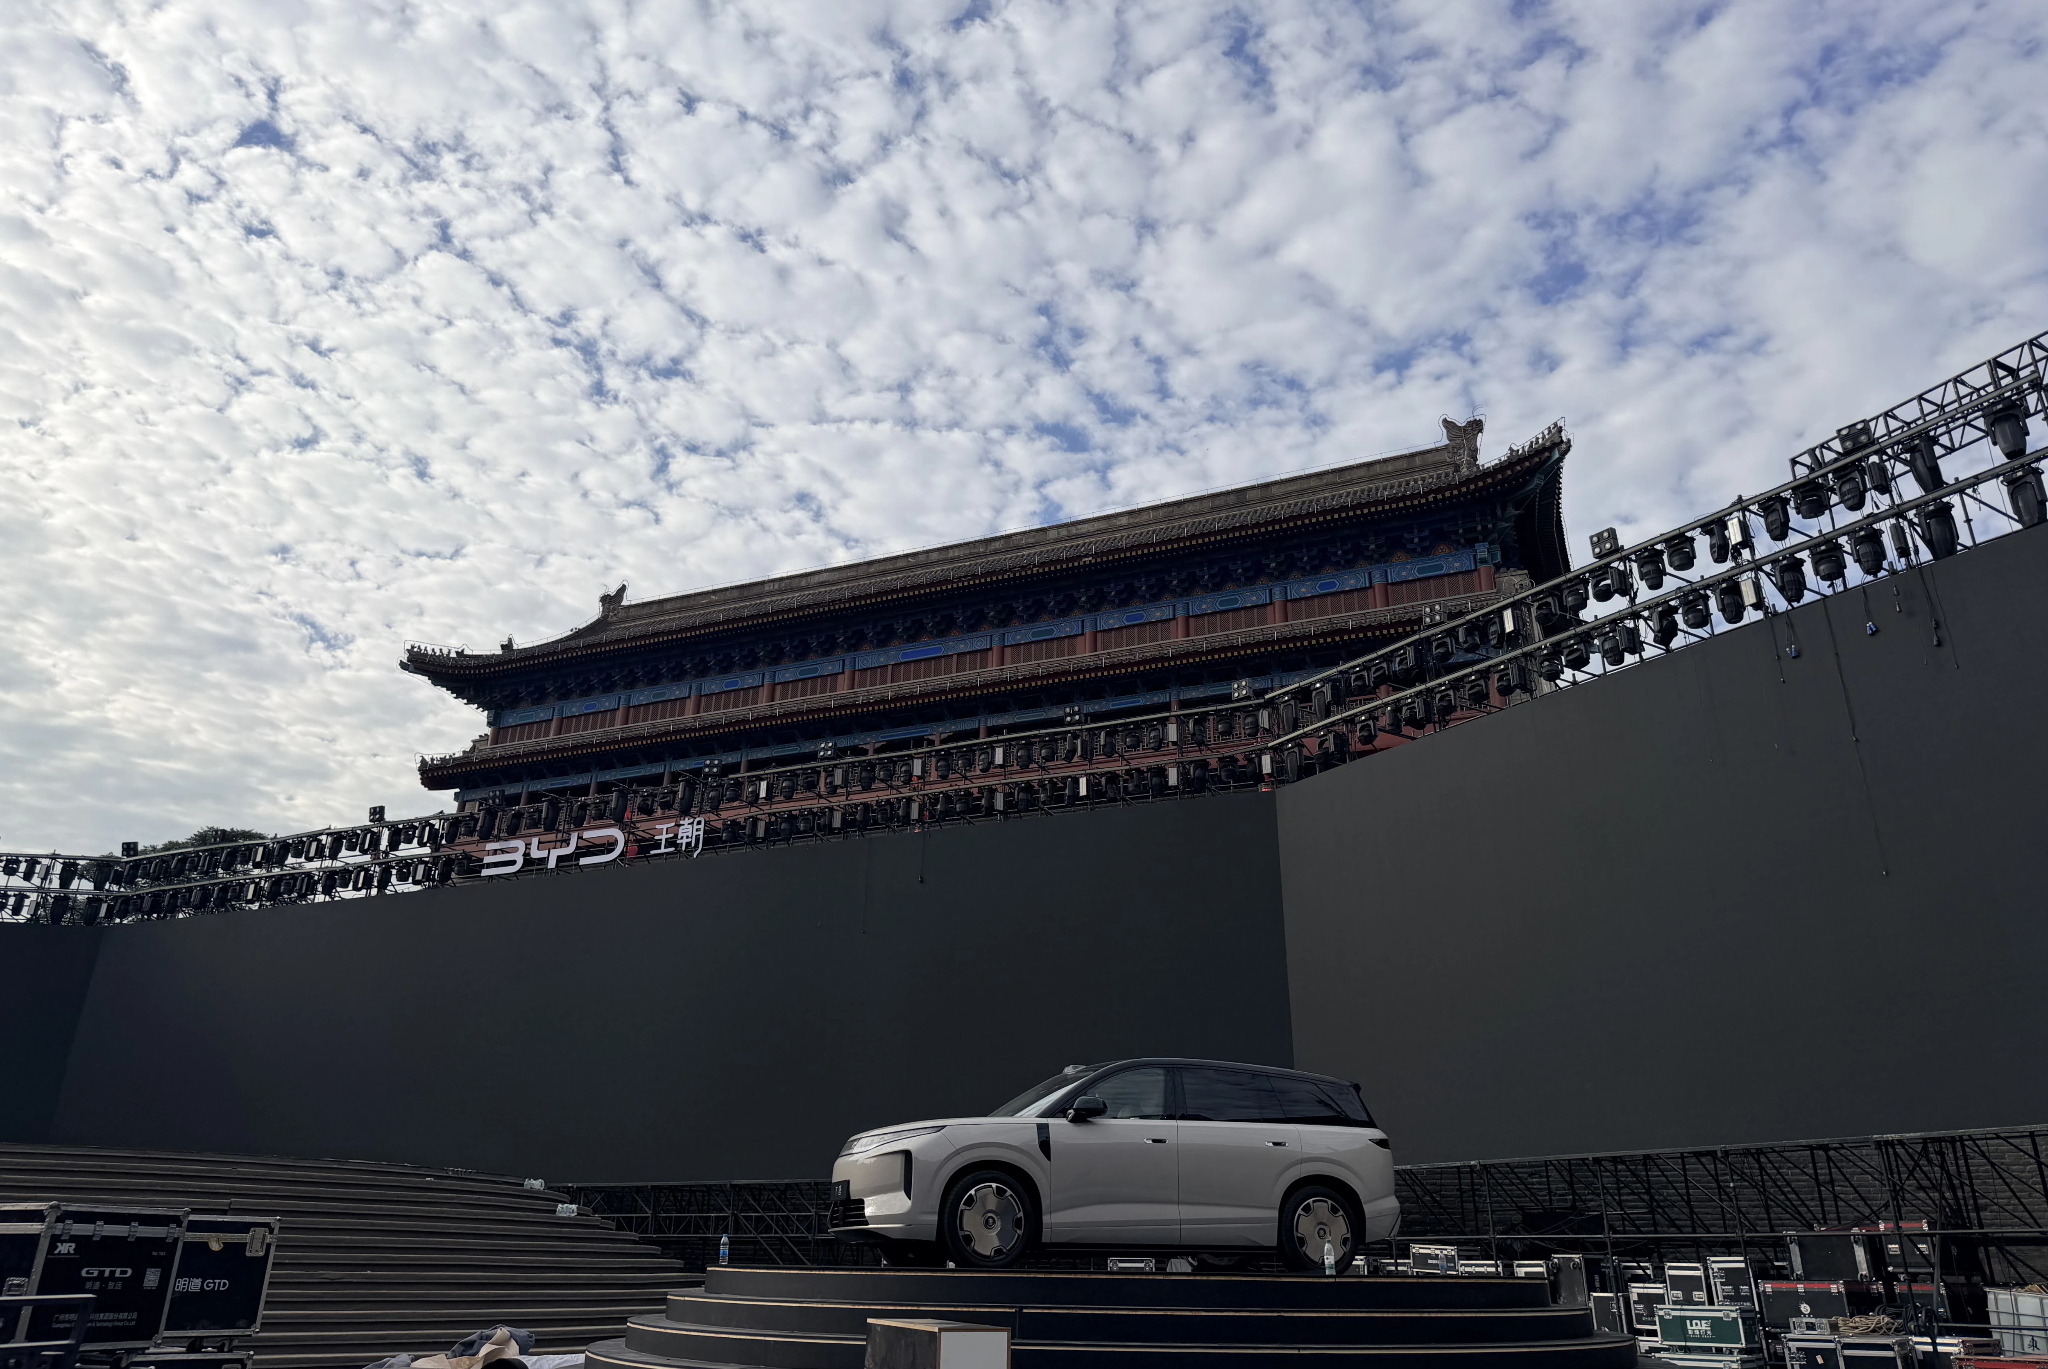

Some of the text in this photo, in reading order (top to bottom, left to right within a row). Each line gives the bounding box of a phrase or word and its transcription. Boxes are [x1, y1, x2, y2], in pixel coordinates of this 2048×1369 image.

[481, 816, 705, 877] BYD 王朝
[80, 1267, 132, 1278] GTD
[174, 1277, 229, 1292] 明道 GTD
